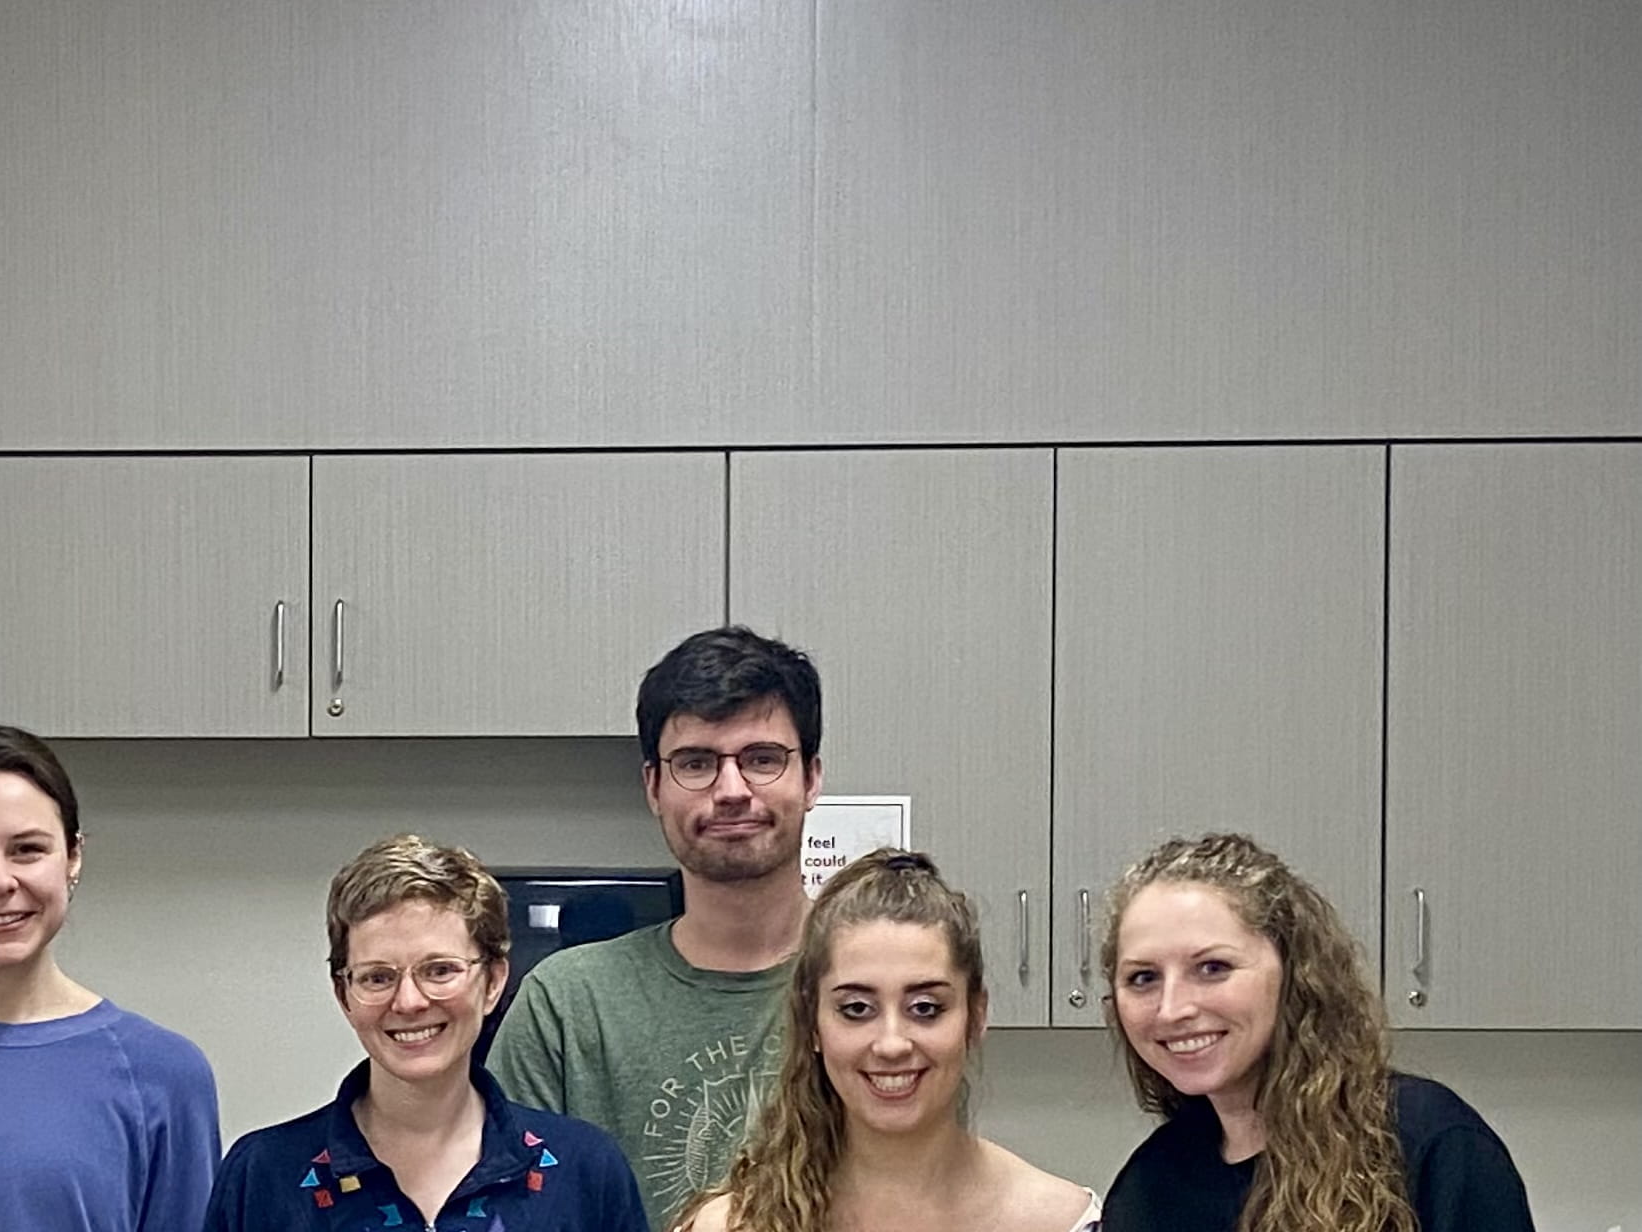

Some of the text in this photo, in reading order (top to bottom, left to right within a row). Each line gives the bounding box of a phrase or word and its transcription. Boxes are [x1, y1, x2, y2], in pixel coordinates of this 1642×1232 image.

[808, 836, 835, 848] feel
[804, 854, 846, 867] could
[811, 873, 823, 885] it
[643, 1077, 685, 1137] FOR
[685, 1035, 749, 1072] THE
